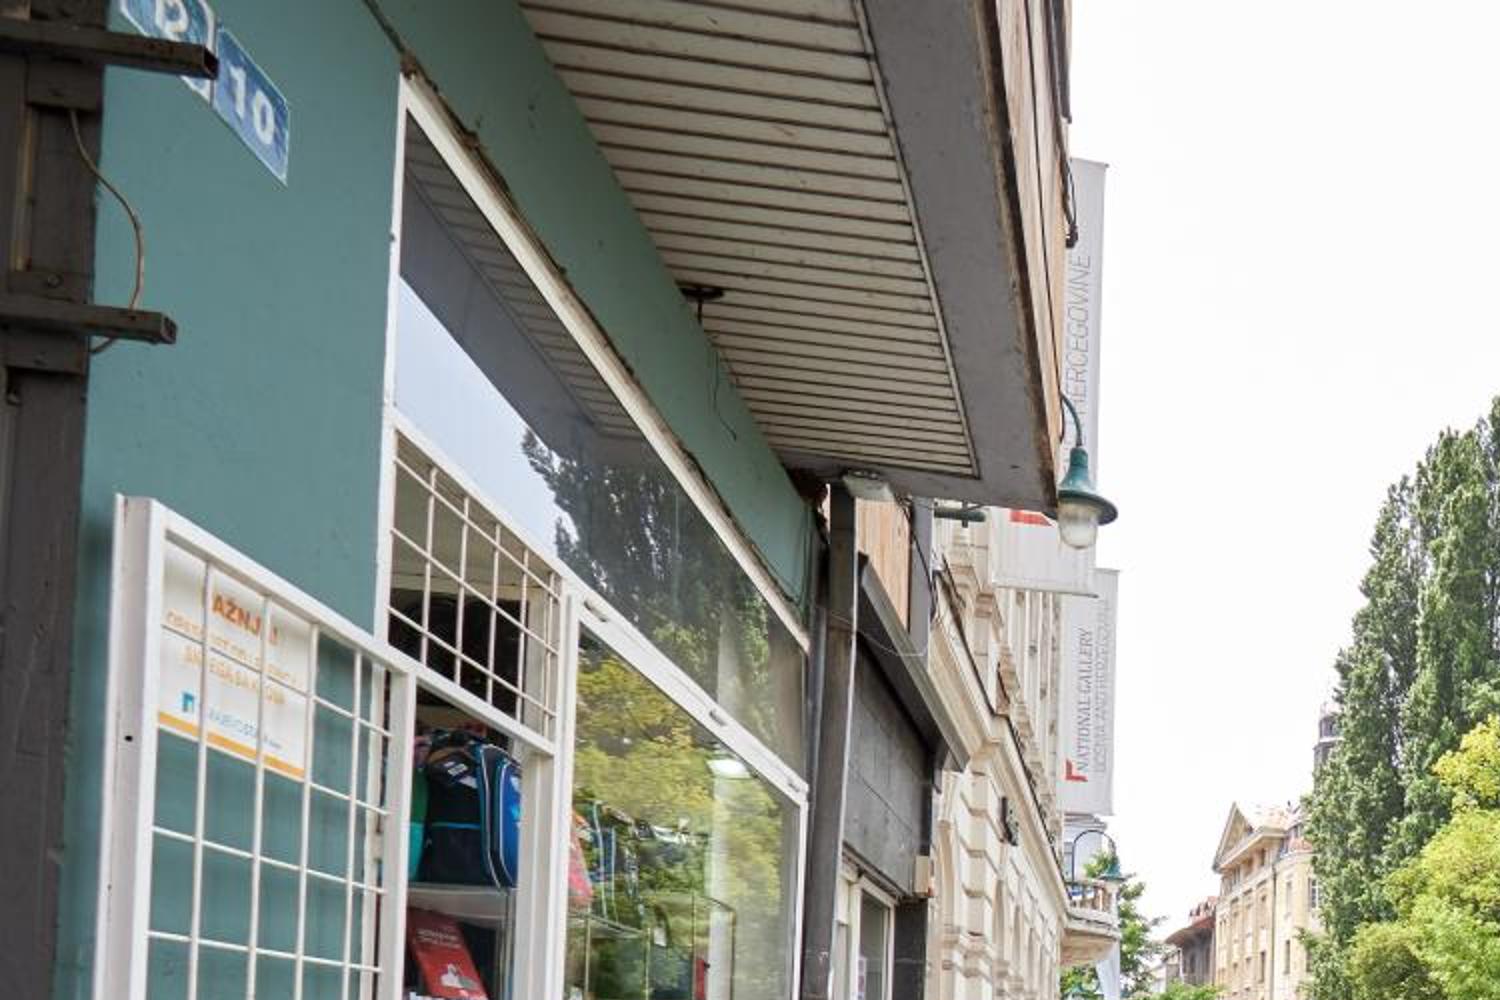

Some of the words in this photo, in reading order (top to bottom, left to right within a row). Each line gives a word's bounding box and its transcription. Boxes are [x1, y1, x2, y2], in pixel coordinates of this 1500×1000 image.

[229, 63, 275, 145] 10
[1077, 628, 1093, 693] GALLERY
[1076, 697, 1091, 772] NATIONAL
